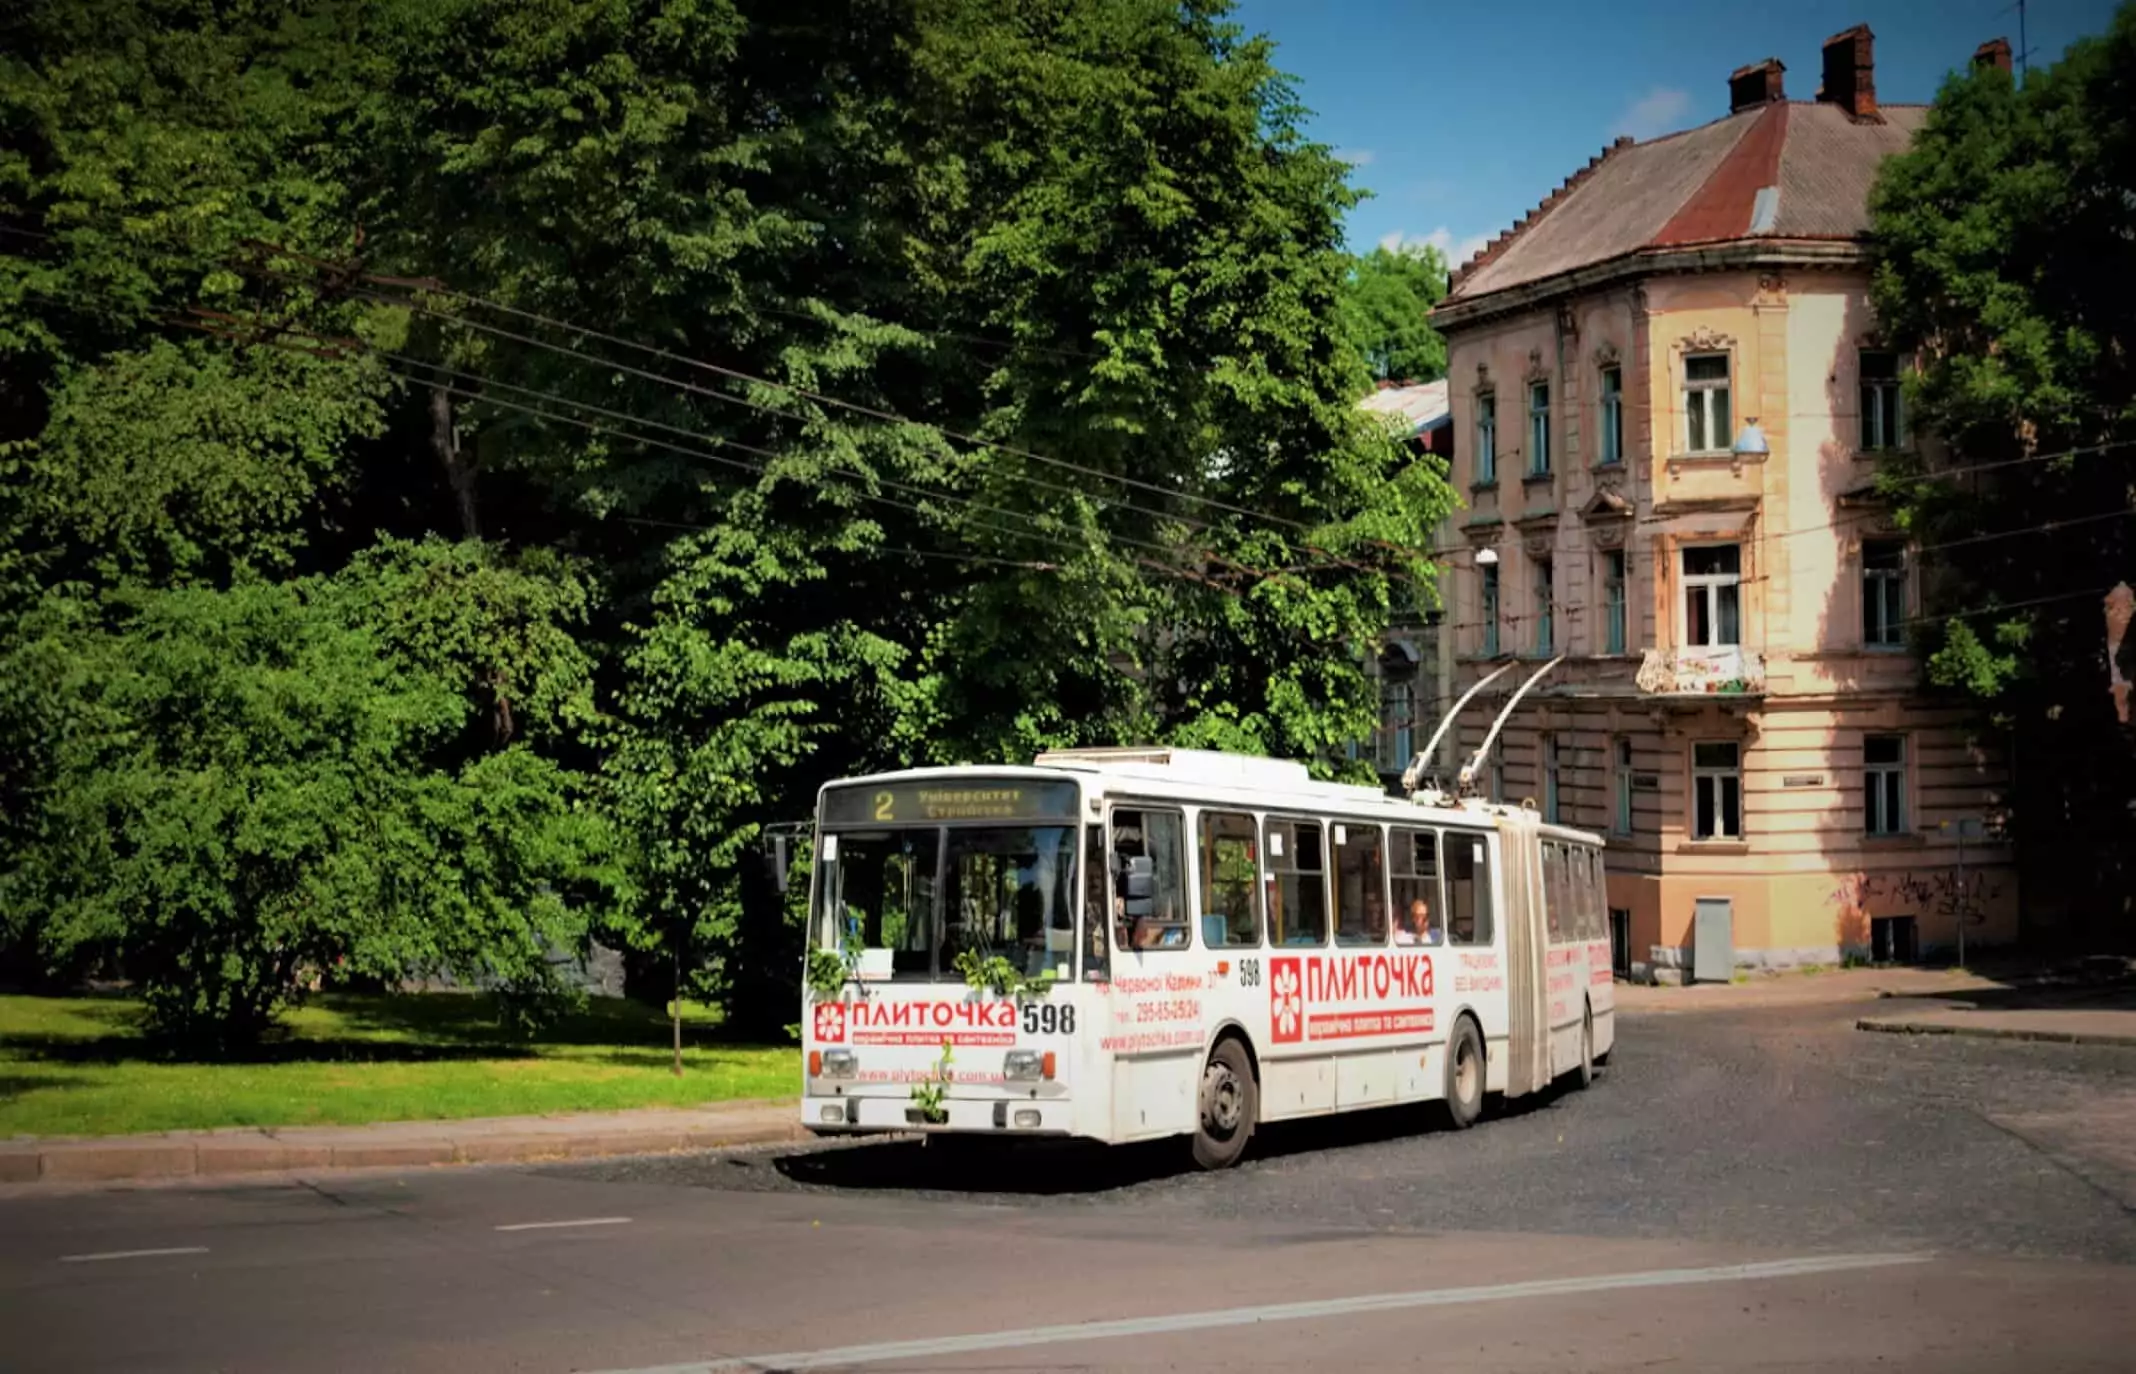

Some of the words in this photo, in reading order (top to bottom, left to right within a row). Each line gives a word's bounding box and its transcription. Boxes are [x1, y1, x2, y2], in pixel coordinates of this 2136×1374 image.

[874, 791, 894, 821] 2
[1238, 957, 1262, 987] 598
[1022, 1003, 1076, 1035] 598
